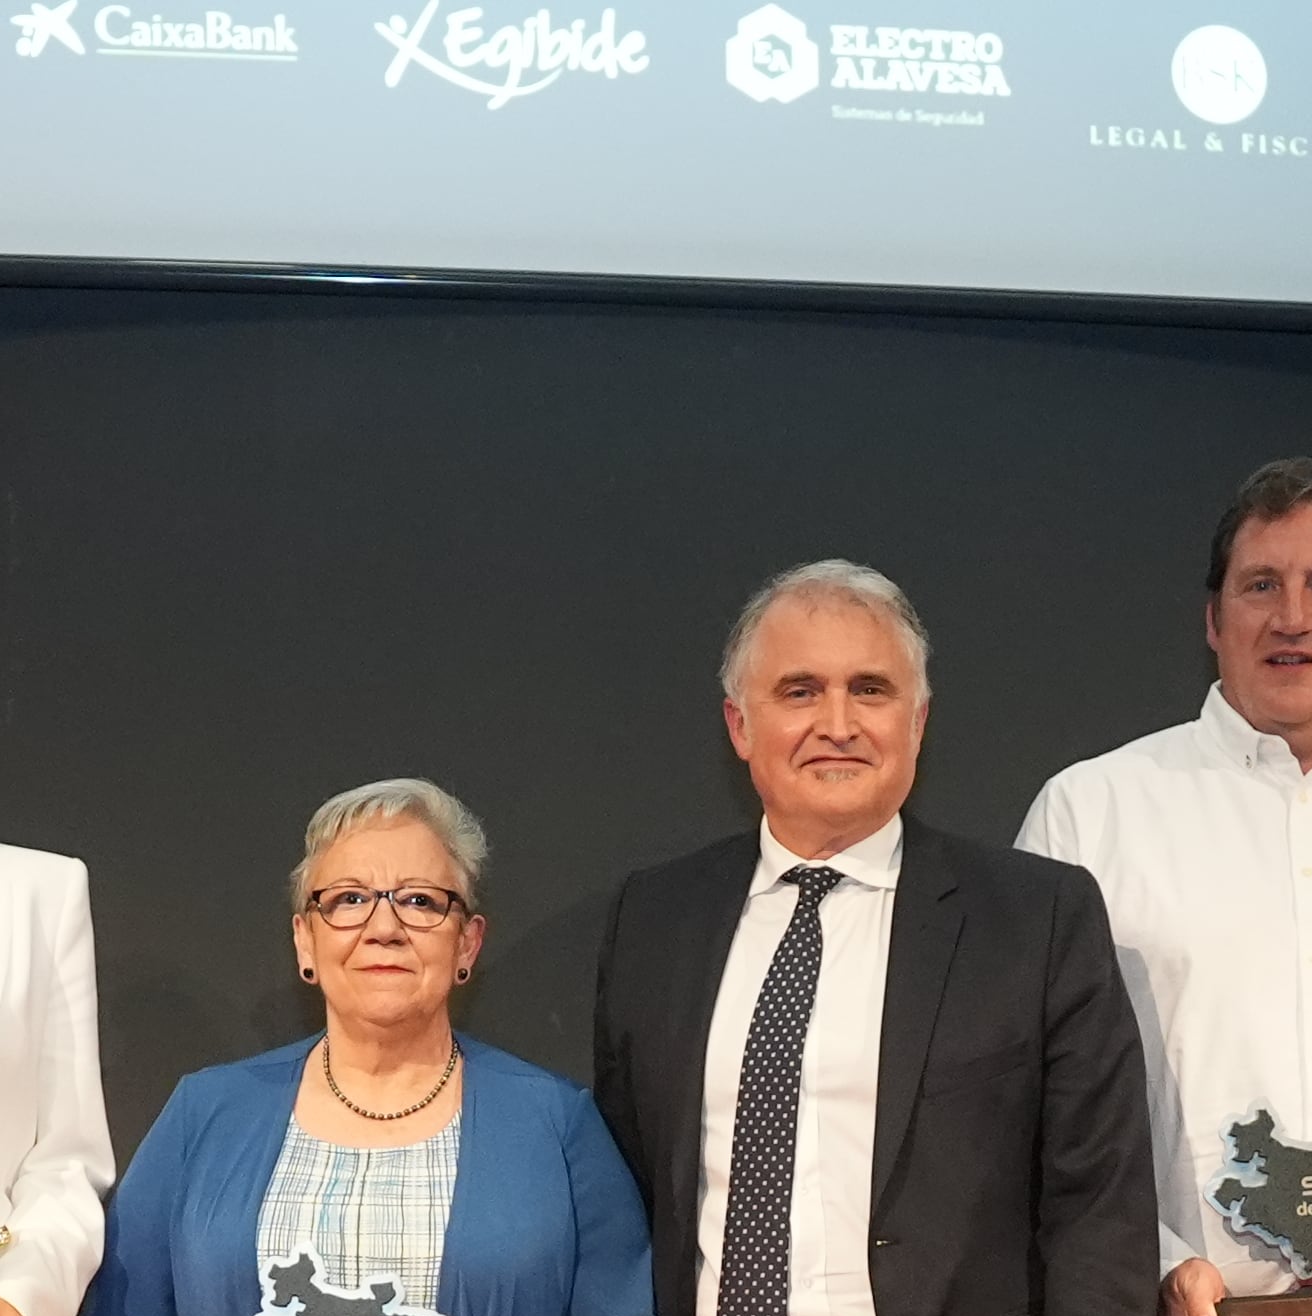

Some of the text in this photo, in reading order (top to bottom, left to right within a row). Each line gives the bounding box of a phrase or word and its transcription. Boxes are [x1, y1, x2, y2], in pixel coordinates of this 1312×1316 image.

[94, 5, 298, 53] CaixaBank
[830, 24, 1003, 63] ELECTRO
[442, 6, 650, 109] Egibide
[831, 57, 1011, 96] ALAVESA
[1089, 125, 1187, 150] LEGAL
[1204, 131, 1224, 152] &
